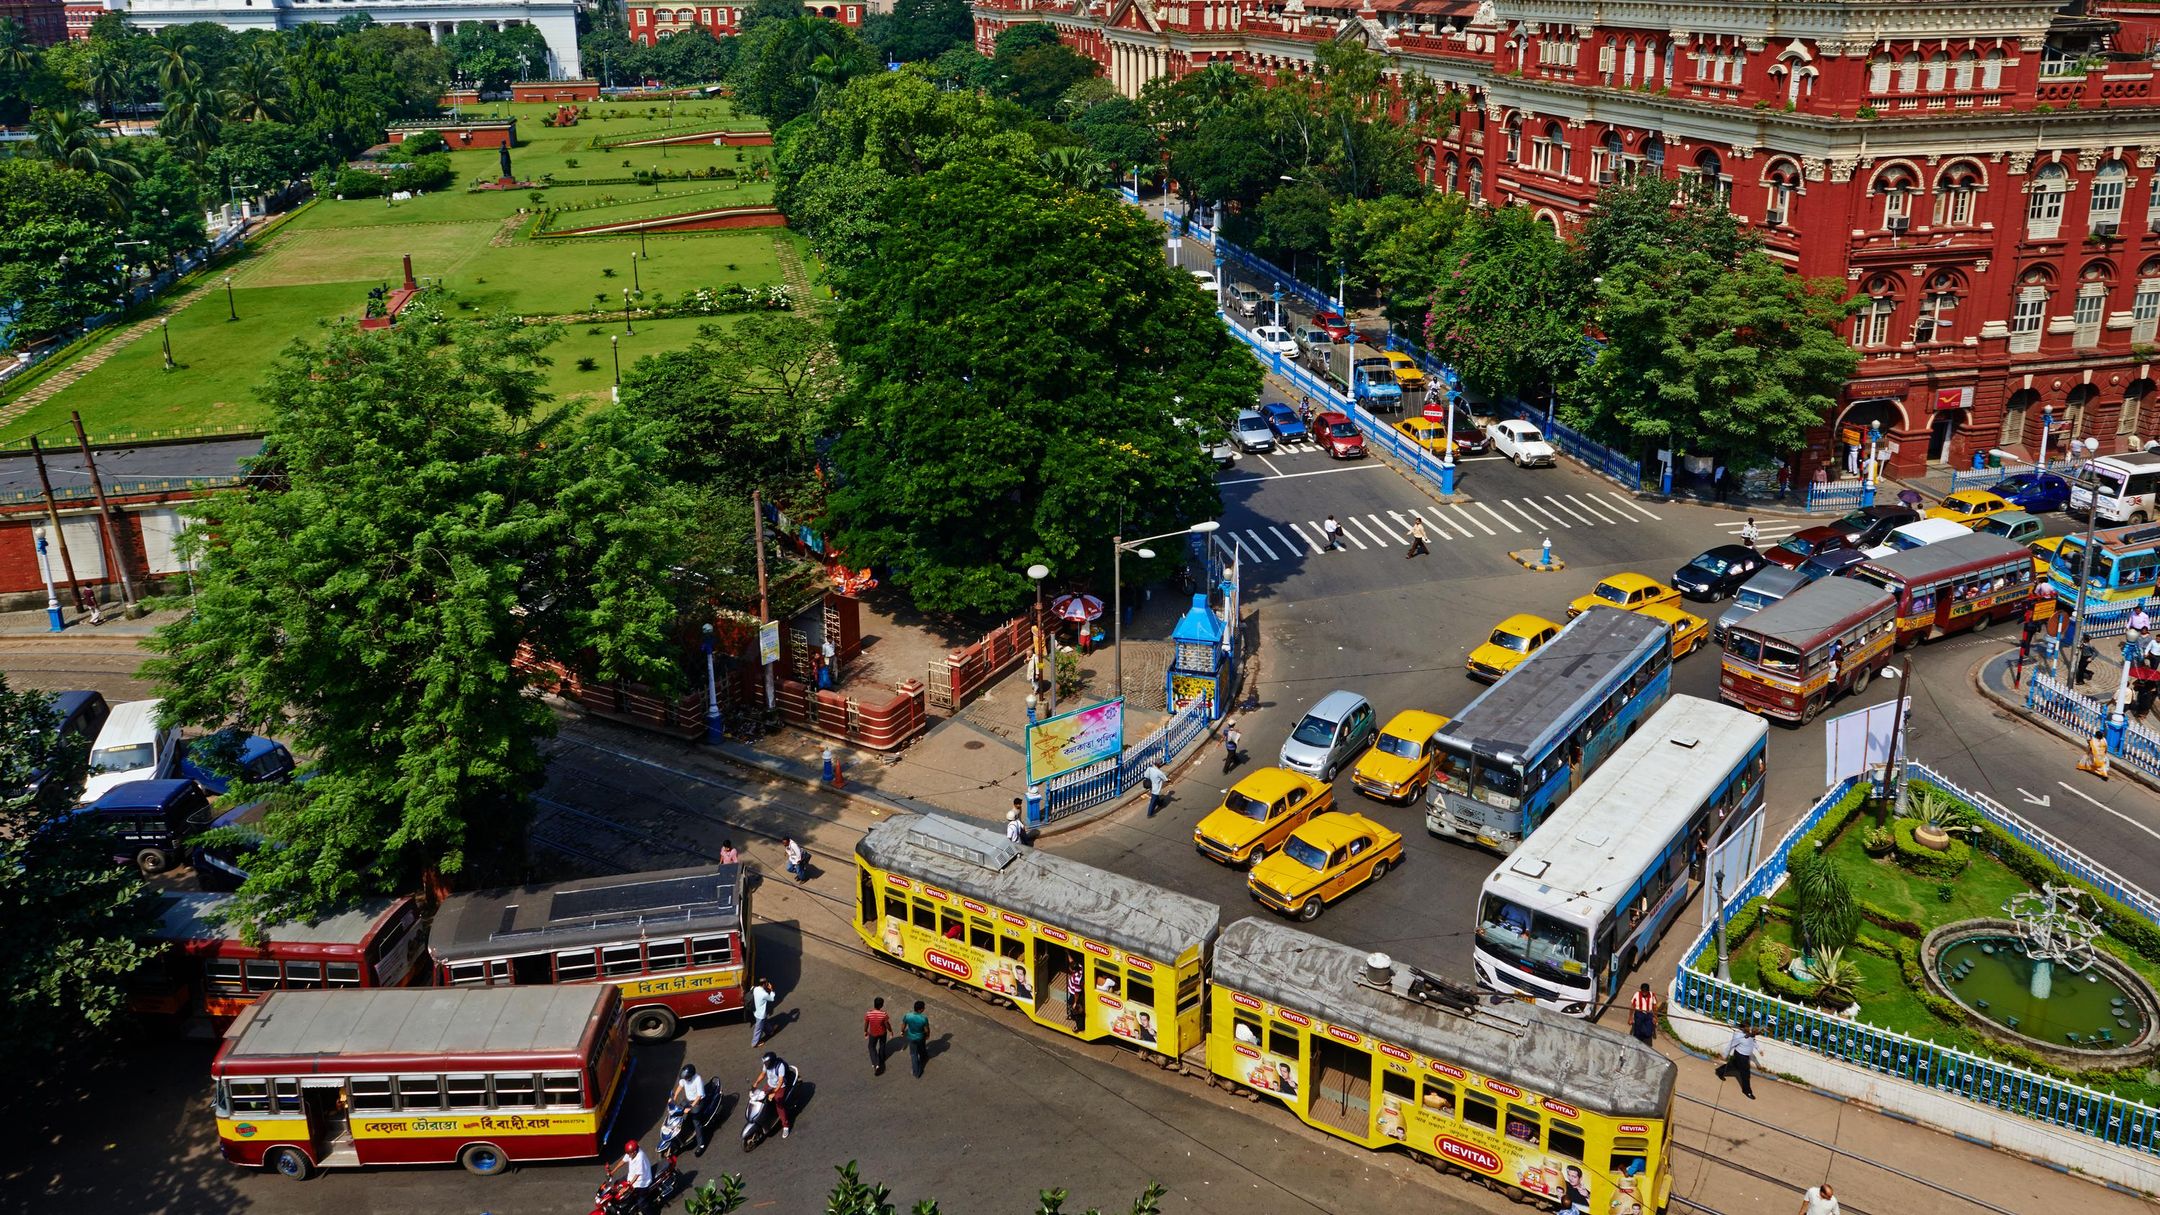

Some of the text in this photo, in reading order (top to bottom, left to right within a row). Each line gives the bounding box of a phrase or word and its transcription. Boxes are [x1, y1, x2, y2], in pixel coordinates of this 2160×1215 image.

[1063, 740, 1094, 755] কলকাতা
[1096, 732, 1117, 747] পুলিশ
[889, 875, 909, 887] REVITAL
[926, 888, 948, 900] REVITAL
[964, 900, 986, 913] REVITAL
[1003, 914, 1026, 926] REVITAL
[1043, 927, 1067, 940] REVITAL
[1085, 942, 1109, 955] REVITAL
[930, 953, 968, 975] REVITAL
[1129, 957, 1152, 970] REVITAL
[1100, 996, 1120, 1008] REVITAL
[1235, 995, 1260, 1008] REVITAL
[1282, 1011, 1308, 1025] REVITAL
[1331, 1029, 1358, 1042] REVITAL
[1236, 1045, 1258, 1058] REVITAL
[1382, 1046, 1410, 1060] REVITAL
[1434, 1064, 1463, 1078] REVITAL
[1489, 1082, 1519, 1096] REVITAL
[1544, 1102, 1576, 1116] REVITAL
[365, 1122, 407, 1133] বেহালা
[1443, 1141, 1497, 1169] REVITAL
[1527, 1171, 1540, 1181] 21
